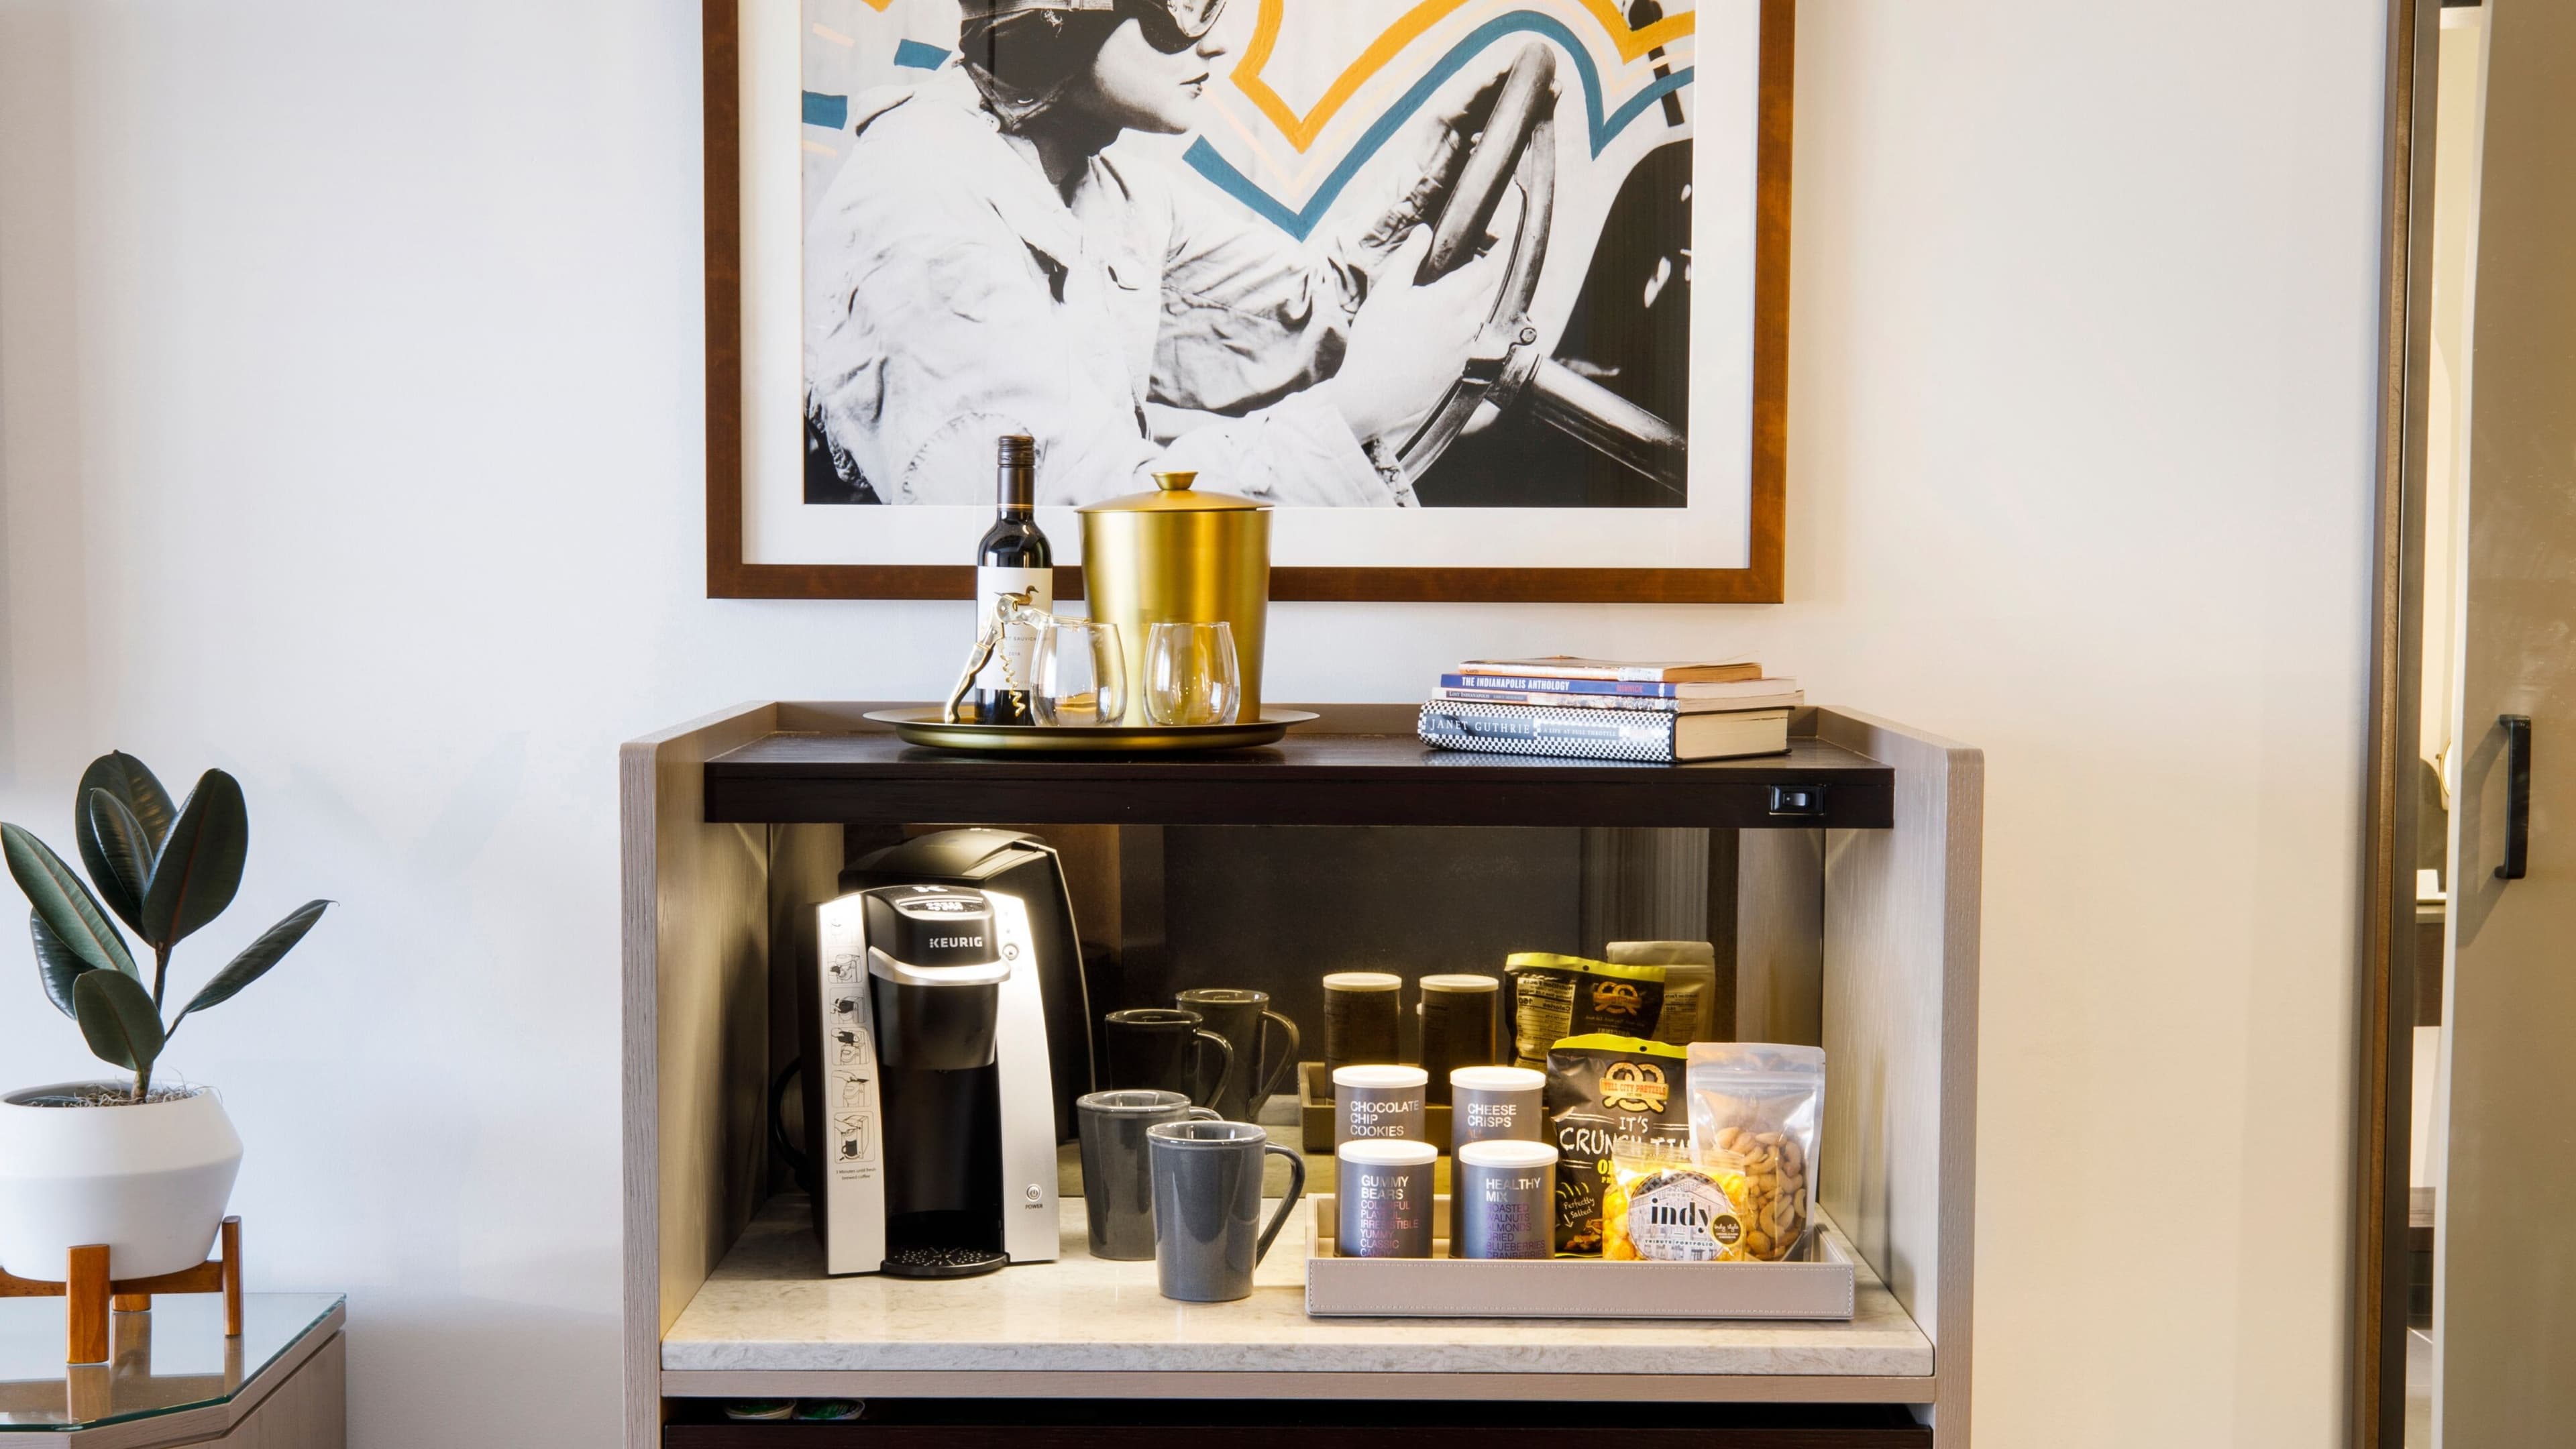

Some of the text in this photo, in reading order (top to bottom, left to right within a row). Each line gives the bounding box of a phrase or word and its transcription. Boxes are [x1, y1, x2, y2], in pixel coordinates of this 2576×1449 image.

[1462, 676, 1475, 686] THE
[1477, 678, 1526, 690] INDIANAPOLIS
[1527, 680, 1570, 692] ANTHOLOGY
[1430, 719, 1530, 734] JANET GUTHRIE
[930, 936, 983, 948] KEURIG
[1604, 1082, 1666, 1095] TELL CITY PRETZELS
[1350, 1100, 1419, 1113] CHOCOLATE
[1468, 1104, 1517, 1116] CHEESE
[1350, 1113, 1378, 1124] CHIP
[1468, 1115, 1511, 1128] CRISPS
[1619, 1116, 1648, 1133] IT'S
[1350, 1125, 1404, 1136] COOKIES
[1361, 1175, 1409, 1187] GUMMY
[1486, 1177, 1541, 1189] HEALTHY
[1361, 1187, 1403, 1199] BEARS
[1486, 1190, 1508, 1202] MIX
[1360, 1199, 1410, 1210] COLFUL
[1564, 1197, 1595, 1210] Perfectly
[1570, 1206, 1593, 1218] Salted
[1652, 1197, 1709, 1233] indy
[1360, 1220, 1418, 1229] IRRESSTIBLE
[1360, 1229, 1394, 1238] YUMMY
[1360, 1238, 1399, 1249] CLASSIC
[1487, 1240, 1546, 1251] BLUEBERRIES
[1360, 1248, 1391, 1257] CANDY
